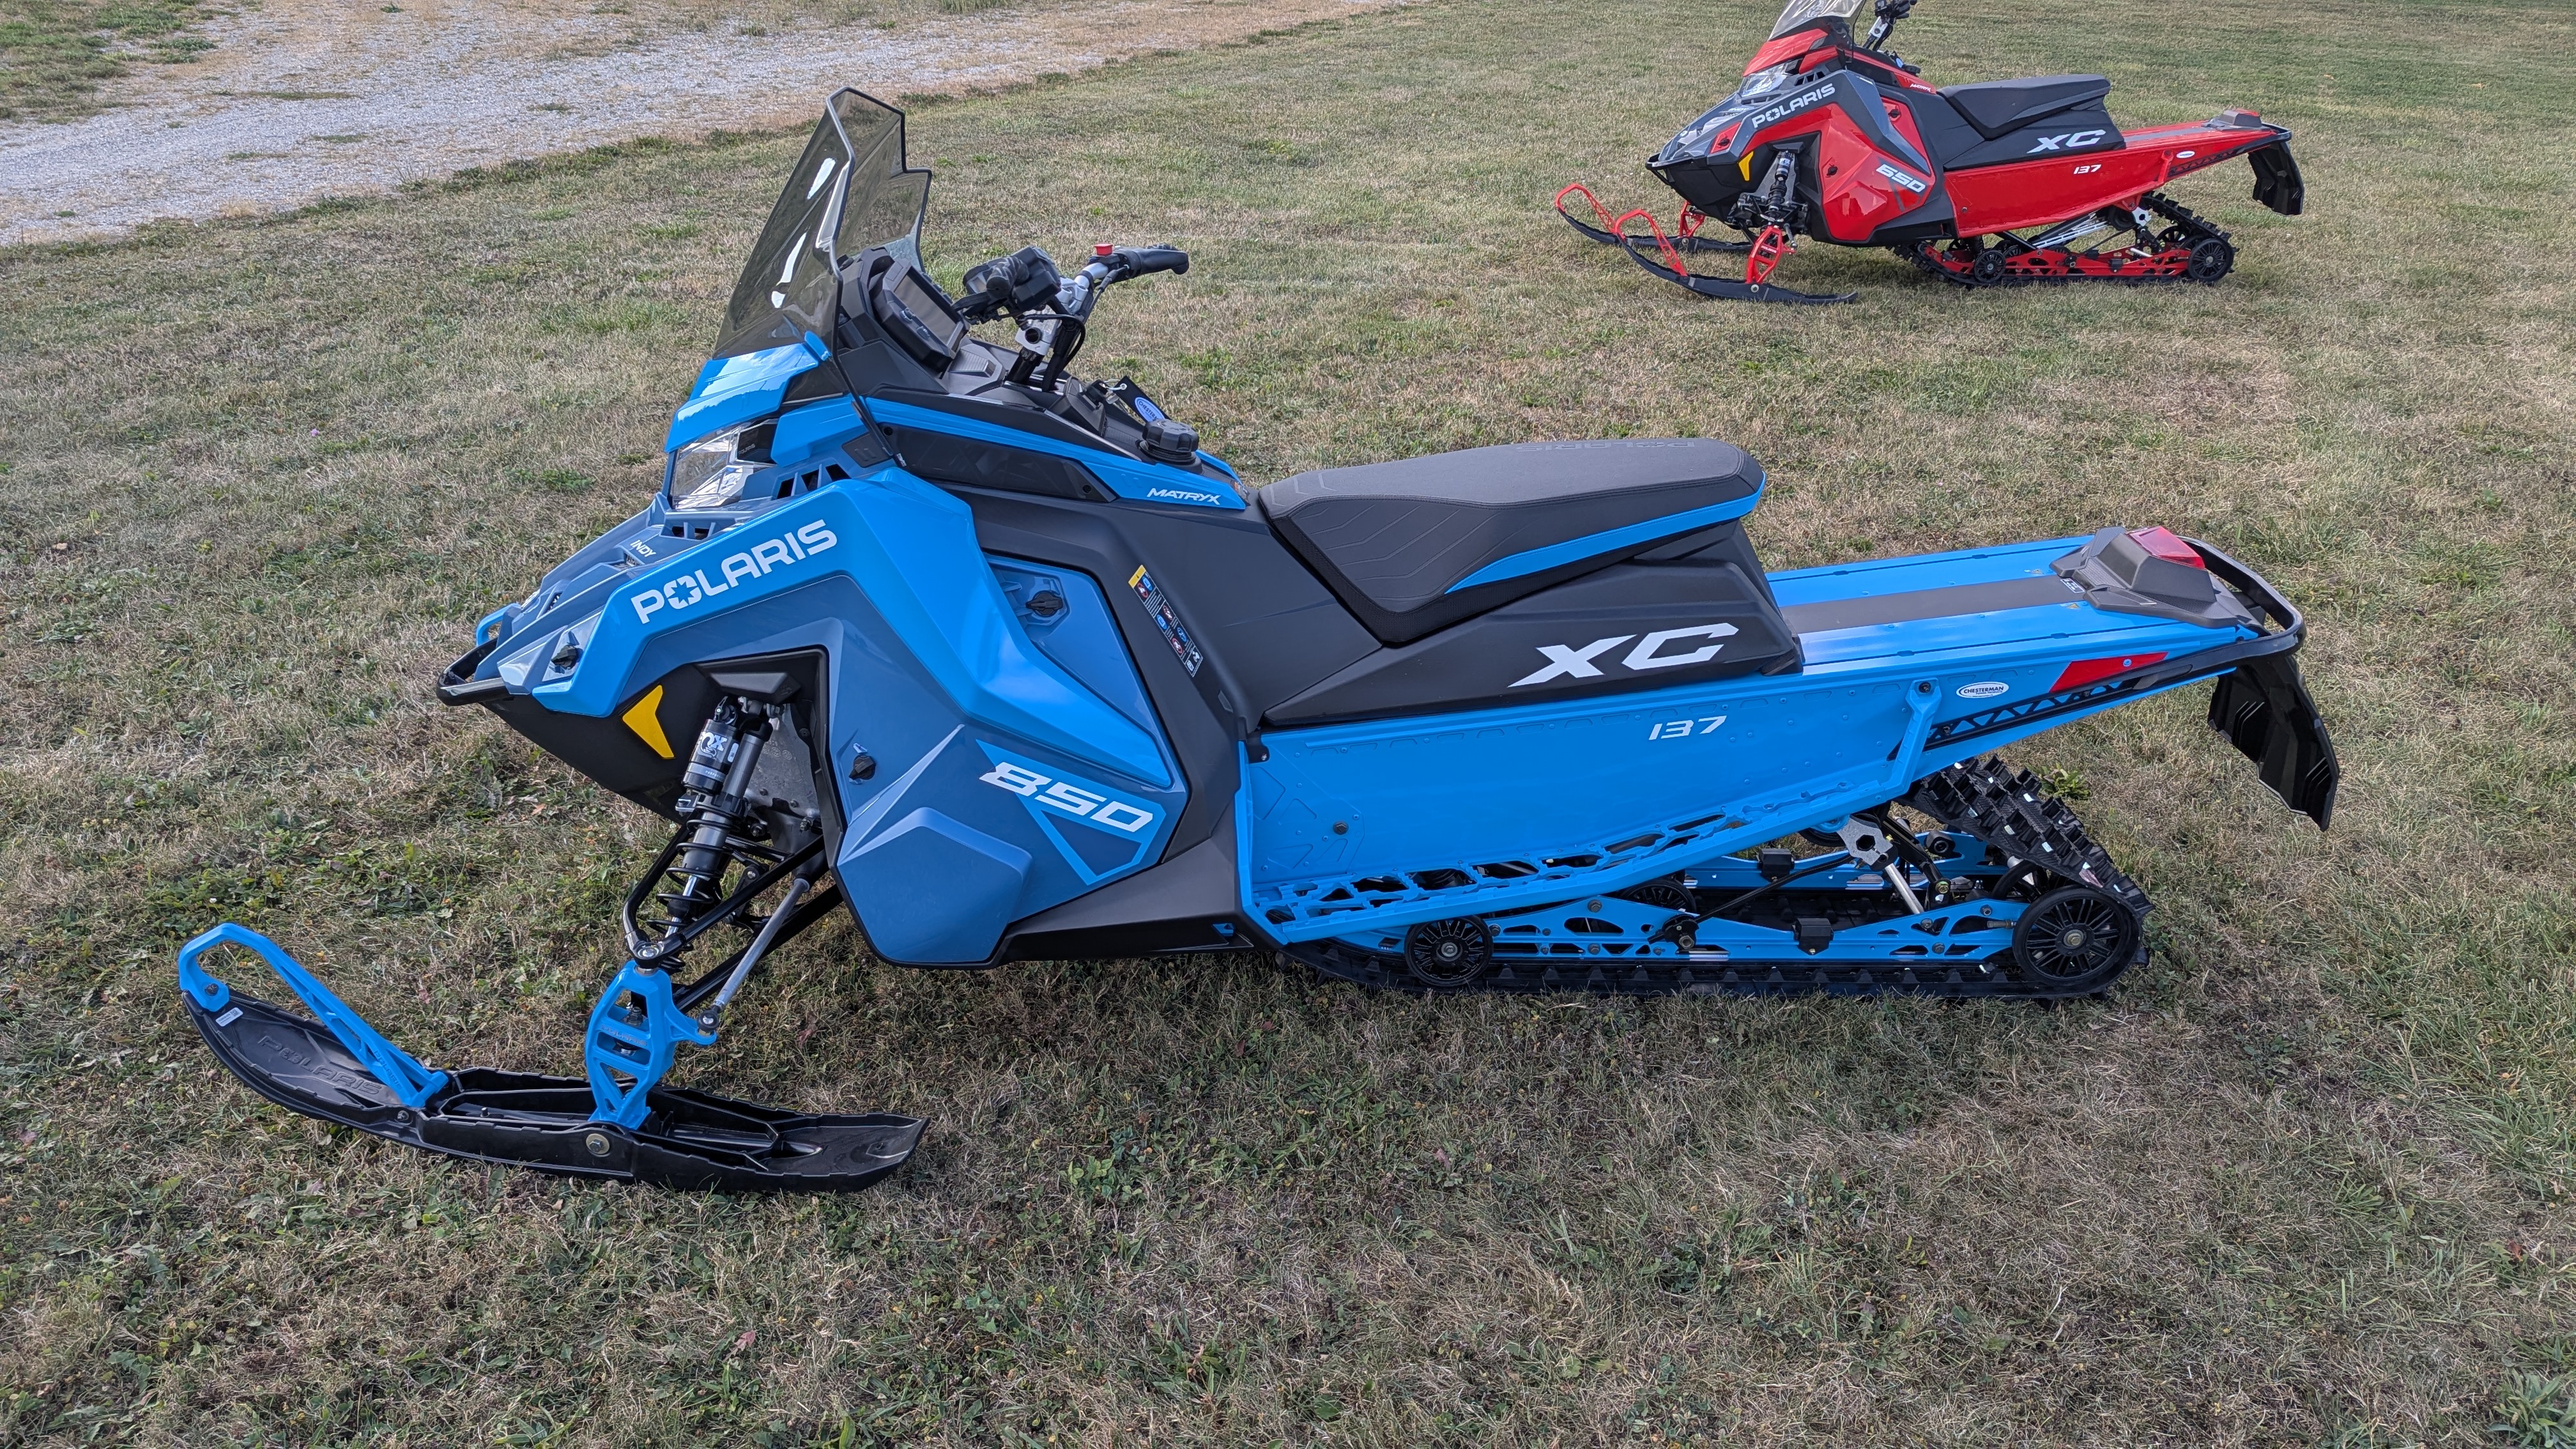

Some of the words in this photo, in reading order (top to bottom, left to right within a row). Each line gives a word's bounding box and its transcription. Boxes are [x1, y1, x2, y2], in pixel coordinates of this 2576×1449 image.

[1751, 82, 1836, 128] POLARIS
[2026, 129, 2106, 154] XC
[1876, 164, 1926, 192] 650
[2073, 164, 2102, 174] 137
[1147, 487, 1222, 505] MATRYX
[630, 539, 657, 558] INDY
[631, 519, 838, 624] POLARIS
[1507, 622, 1739, 687] XC
[1648, 716, 1728, 740] 137
[700, 732, 728, 757] OX
[979, 762, 1153, 832] 850
[257, 1034, 383, 1095] POLARIS
